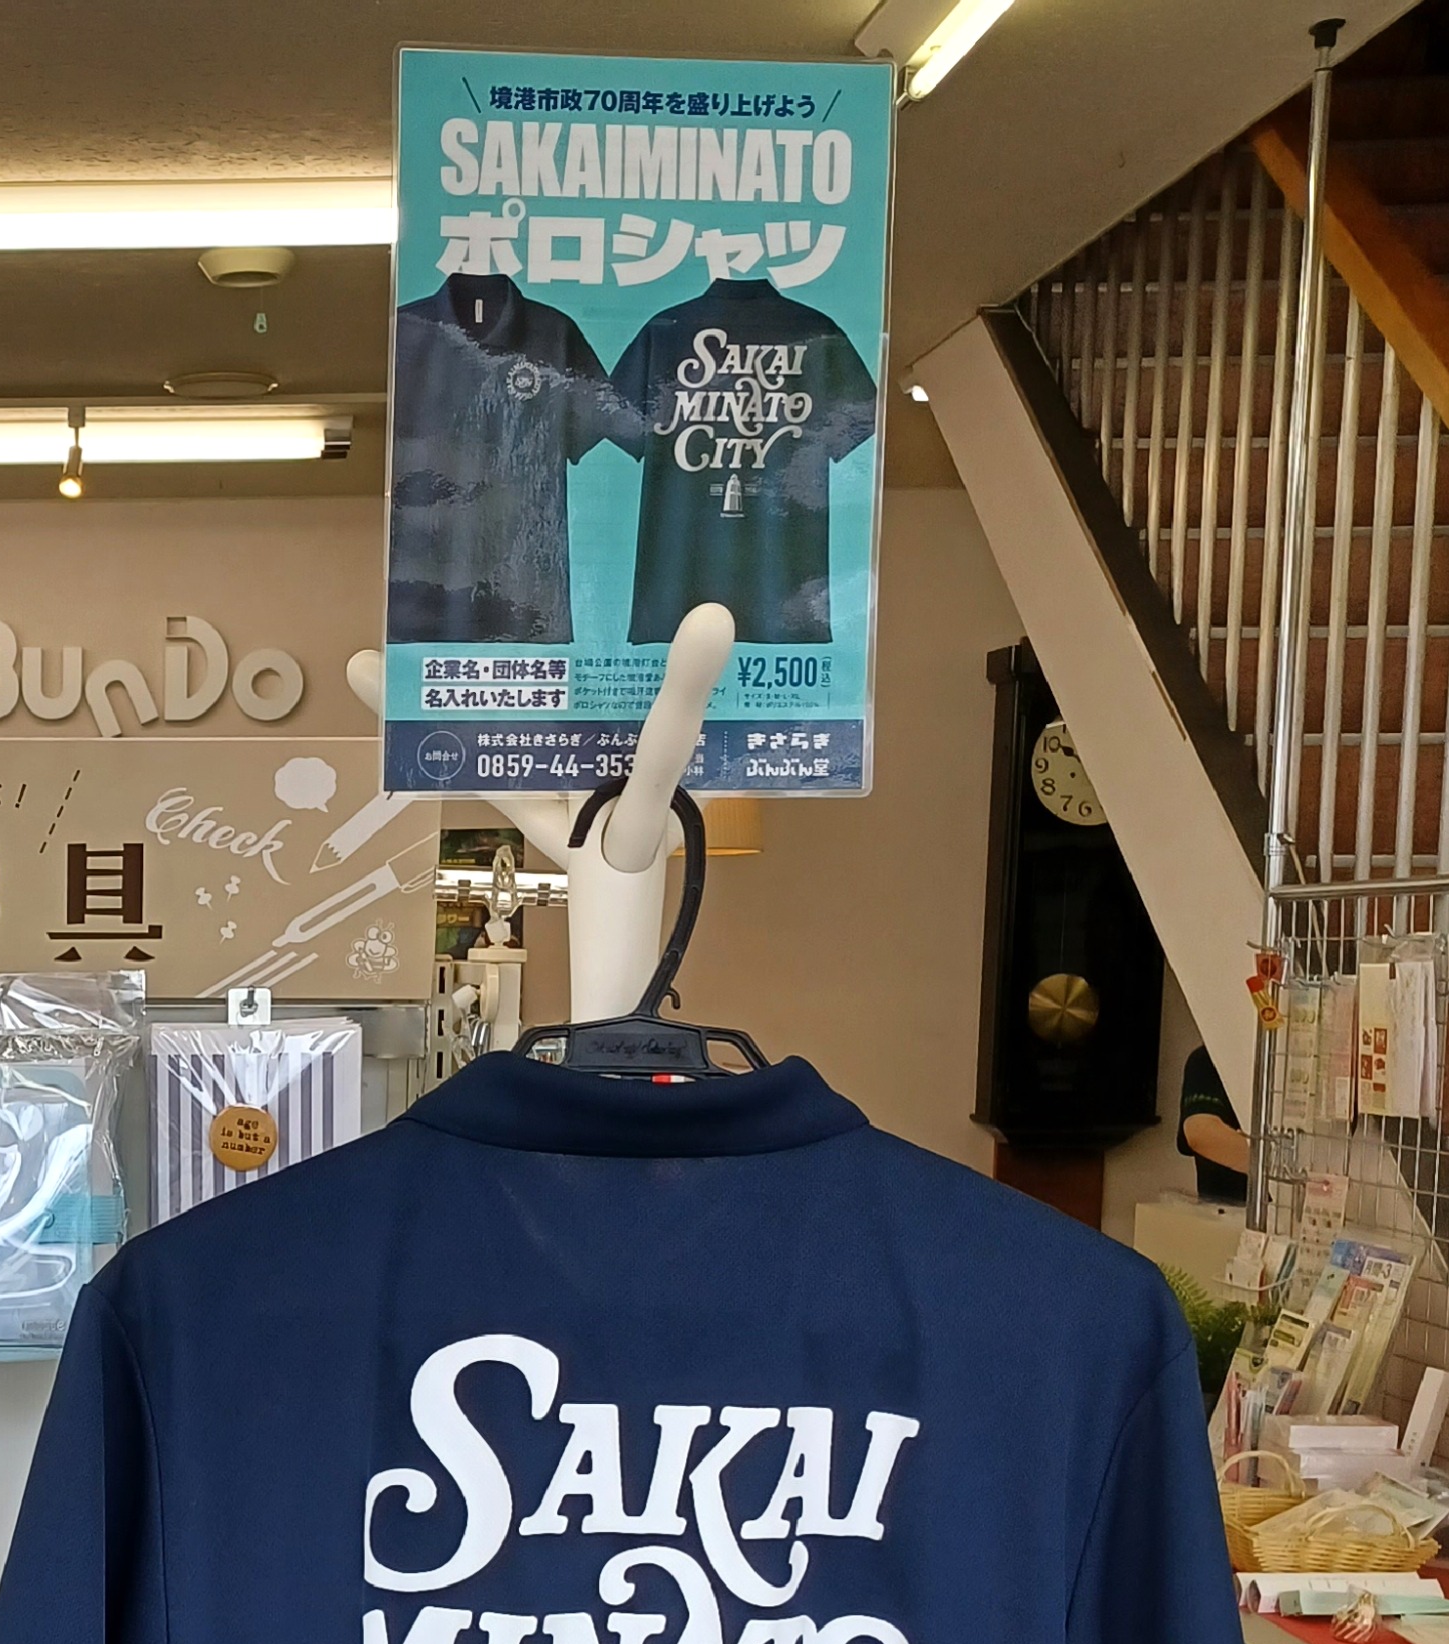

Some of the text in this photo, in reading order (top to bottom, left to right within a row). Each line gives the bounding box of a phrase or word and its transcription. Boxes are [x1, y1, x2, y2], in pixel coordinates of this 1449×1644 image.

[490, 86, 816, 119] 境港市政70周年を盛り上げよう
[440, 117, 852, 206] SAKAIMINATO
[436, 197, 847, 289] ポロシャツ
[676, 328, 808, 390] SAKAI
[653, 377, 813, 437] MINATO
[673, 424, 803, 472] CITY
[425, 659, 567, 680] 企業名・団体名等
[738, 656, 818, 690] ¥2,500
[425, 689, 566, 708] 名入れいたします
[747, 732, 831, 750] きさらぎ
[1043, 736, 1060, 753] 10
[477, 754, 636, 778] 0859-44-353
[747, 758, 830, 777] ぶんぶん堂
[1035, 757, 1049, 774] 9
[1040, 778, 1056, 796] 8
[1060, 795, 1073, 812] 7
[1078, 801, 1092, 817] 6
[144, 786, 292, 885] Check
[364, 1332, 919, 1606] SAKAI
